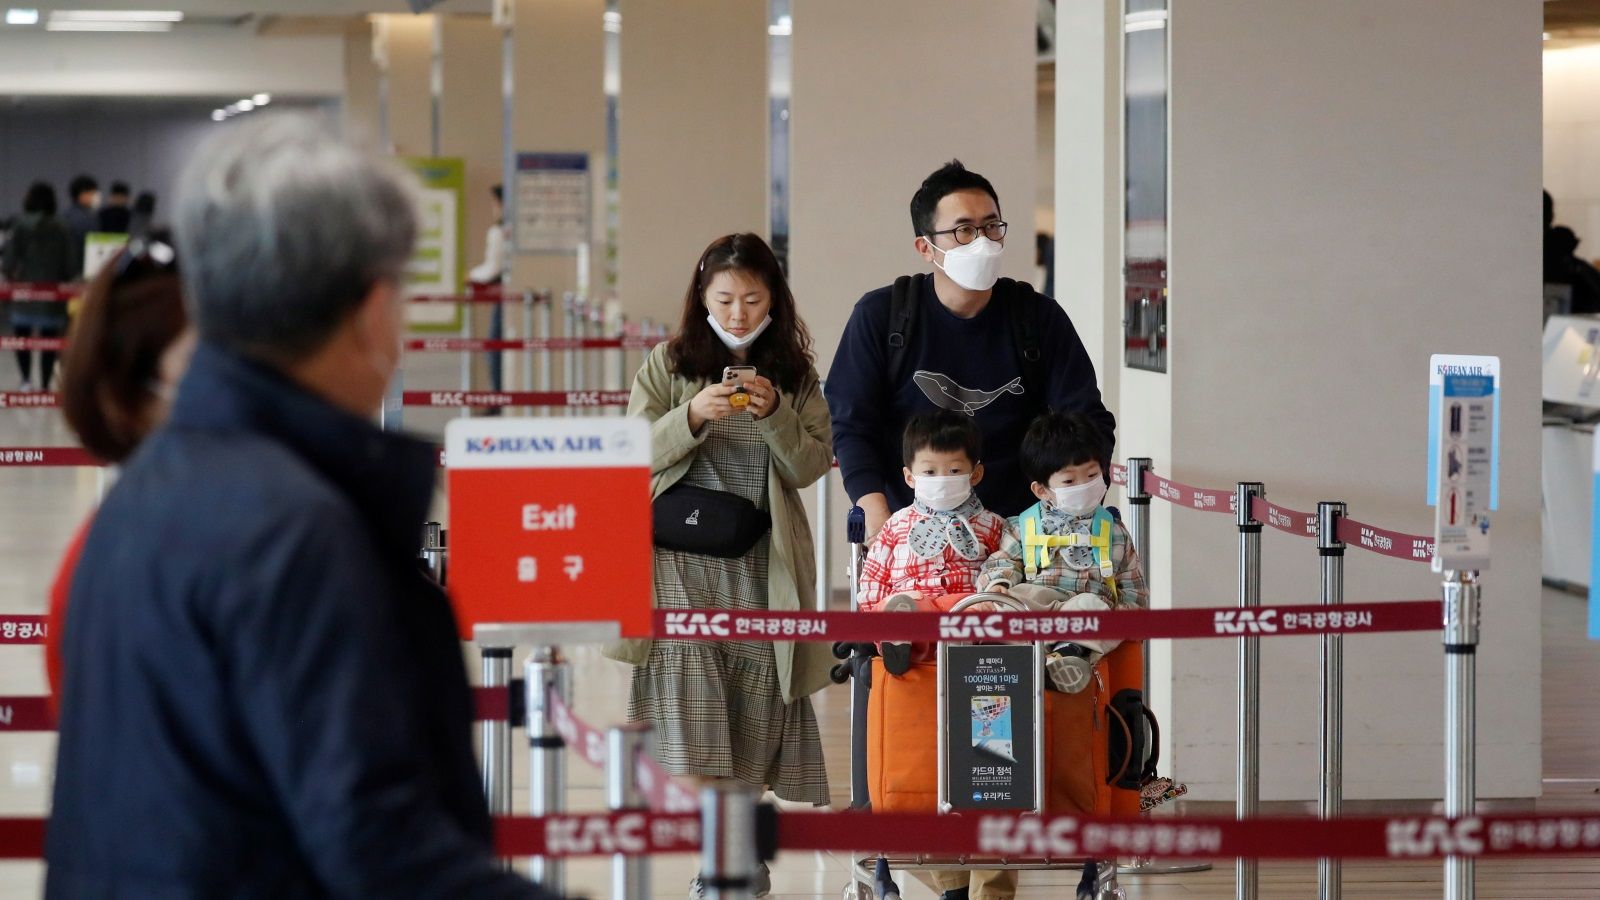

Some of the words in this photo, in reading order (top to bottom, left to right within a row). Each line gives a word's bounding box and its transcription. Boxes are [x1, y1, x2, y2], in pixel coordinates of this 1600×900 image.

[1437, 365, 1468, 376] KOREAN
[1469, 366, 1482, 376] AIR
[465, 437, 556, 454] KOREAN
[561, 436, 604, 452] AIR
[522, 503, 577, 531] Exit
[664, 613, 730, 636] KAC
[735, 618, 827, 635] 한국공항공사
[939, 615, 1003, 638] KAC
[1008, 616, 1099, 634] 한국공항공사
[1214, 609, 1278, 634] KAC
[1283, 610, 1373, 629] 한국공항공사
[963, 674, 998, 684] 1000원에
[999, 674, 1019, 684] 1마일
[972, 766, 995, 776] 카드의
[996, 766, 1012, 776] 정석
[982, 792, 1012, 801] 우리카드
[545, 814, 646, 853] KAC
[978, 815, 1079, 853] KAC
[1386, 817, 1485, 856] KAC
